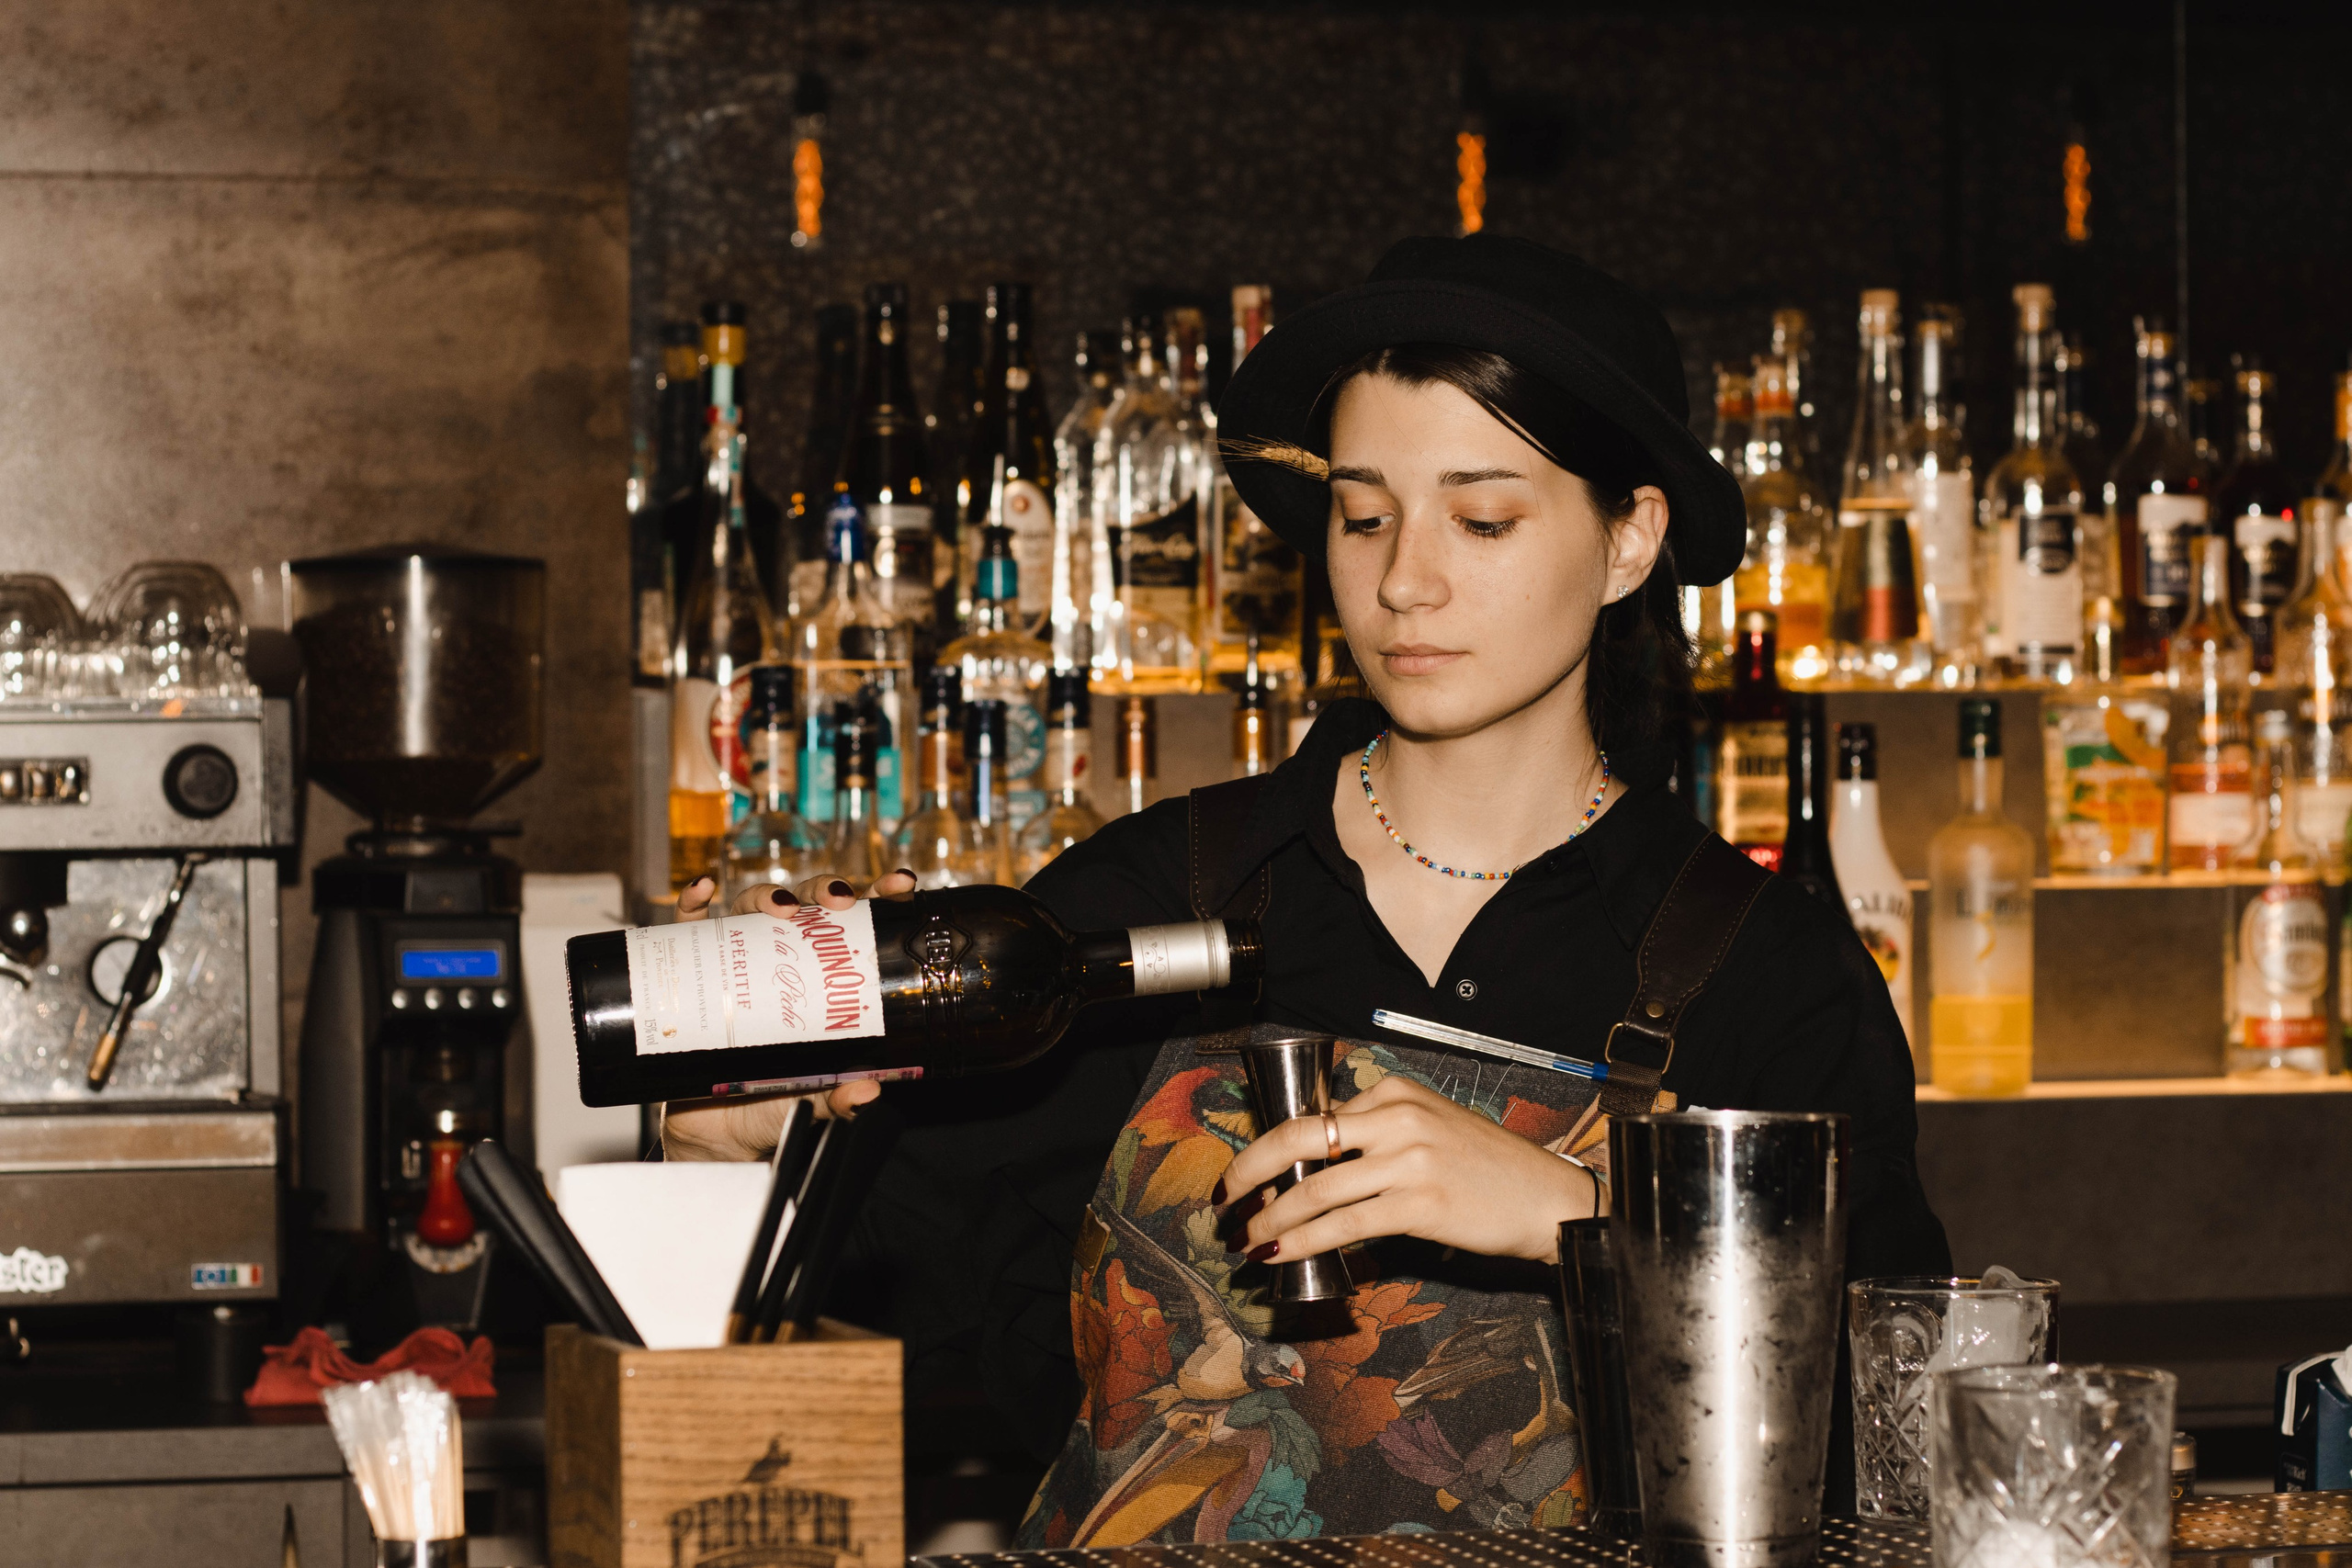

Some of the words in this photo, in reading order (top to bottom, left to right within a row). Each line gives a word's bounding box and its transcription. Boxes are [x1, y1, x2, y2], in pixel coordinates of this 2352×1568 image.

[774, 940, 799, 962] la
[695, 970, 704, 981] EN
[721, 968, 728, 976] DE
[729, 929, 752, 1010] APÉRITIF
[696, 984, 708, 1031] PROVENCE
[772, 964, 808, 1032] Pêche
